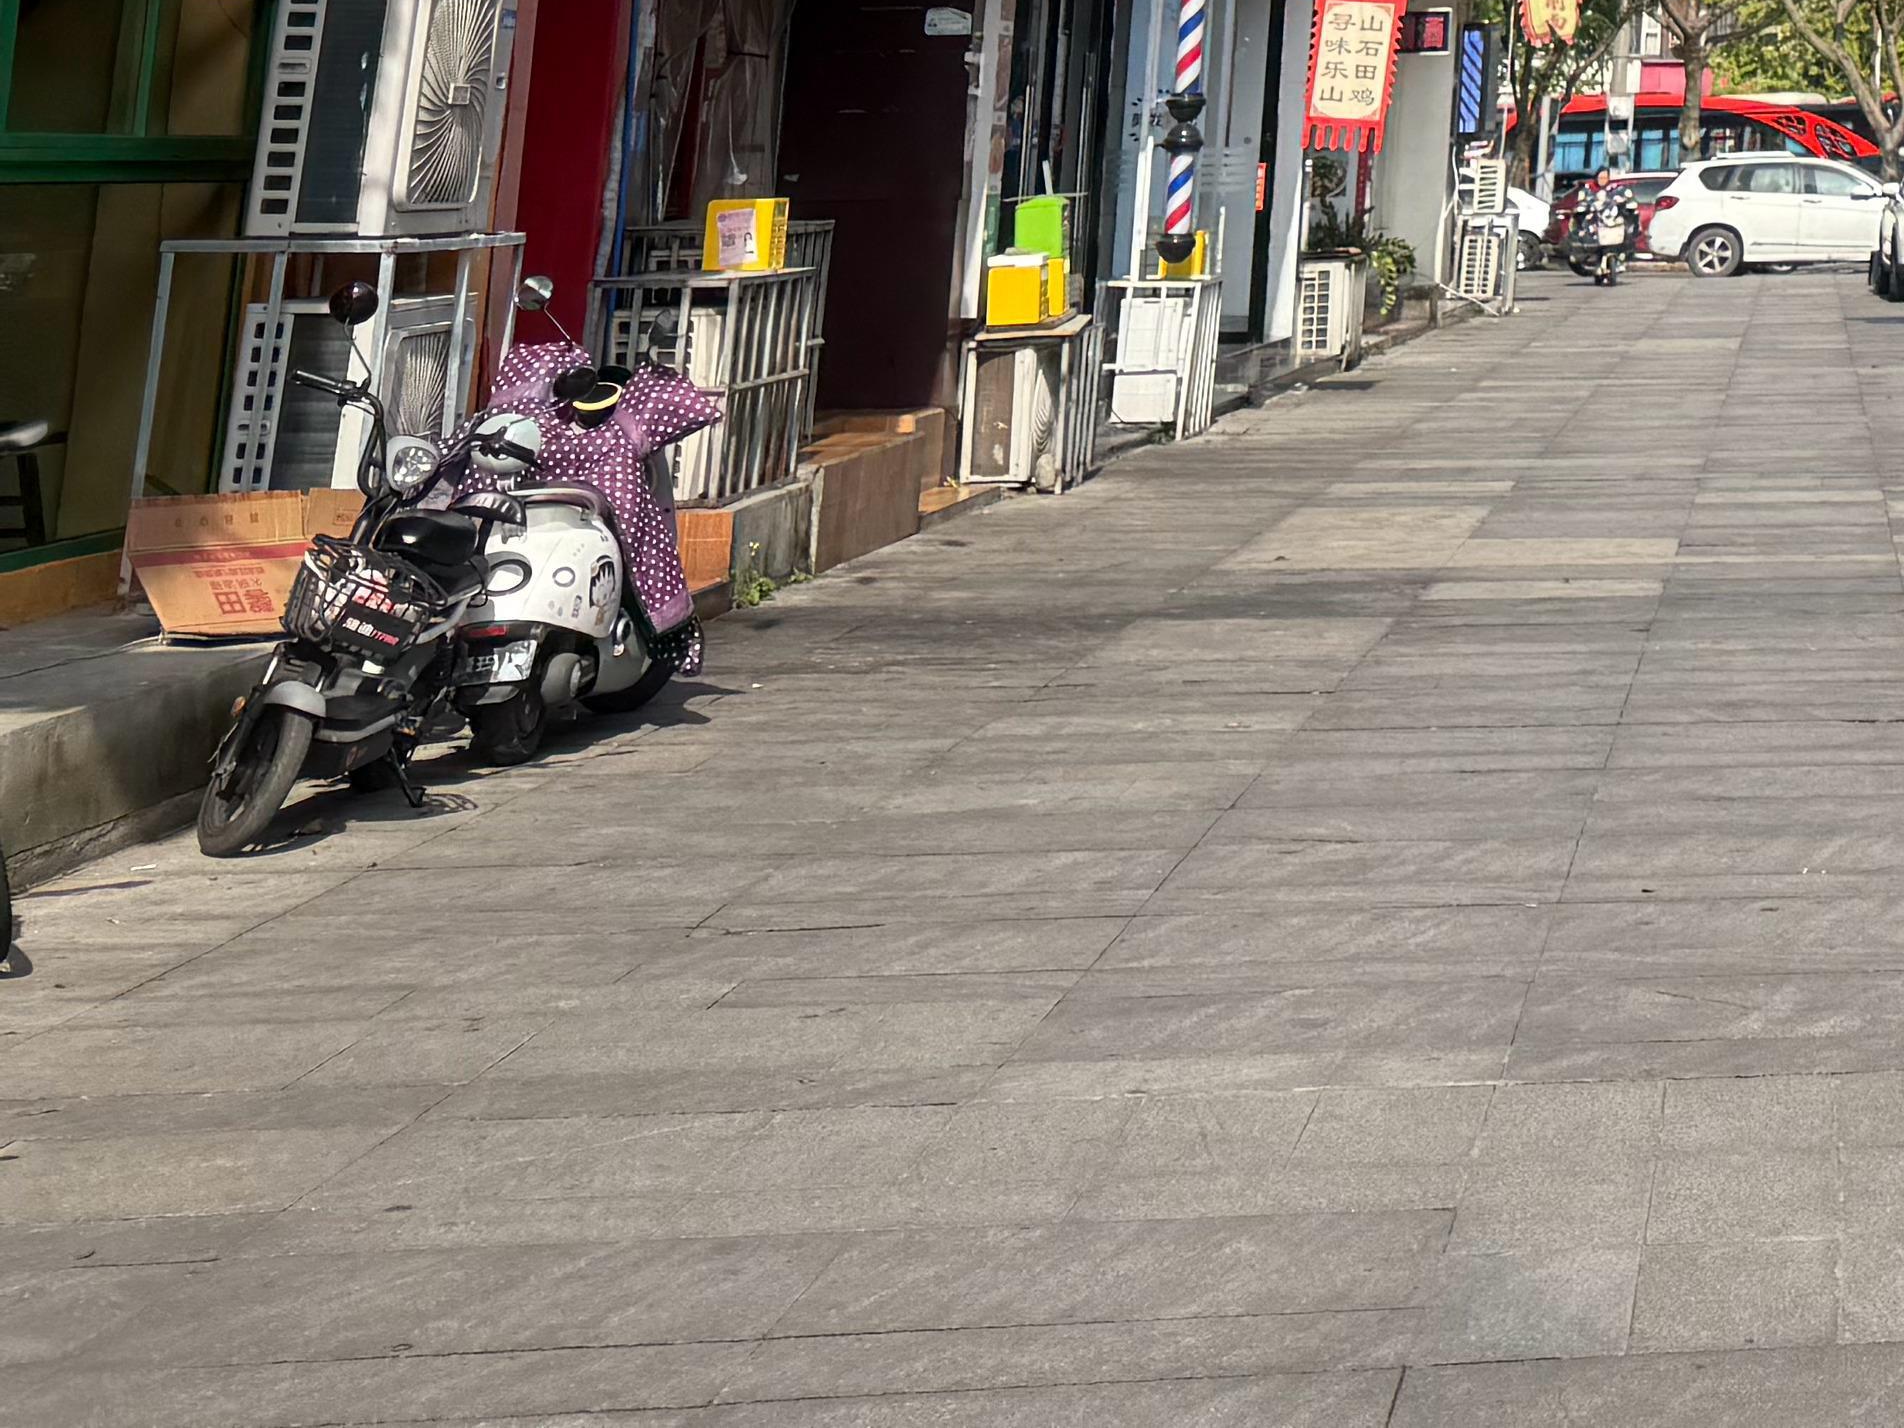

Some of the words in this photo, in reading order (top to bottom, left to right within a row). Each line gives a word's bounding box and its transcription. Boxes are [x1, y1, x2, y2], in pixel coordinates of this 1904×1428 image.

[1319, 12, 1356, 103] 寻味乐山
[1349, 14, 1384, 106] 山石田鸡
